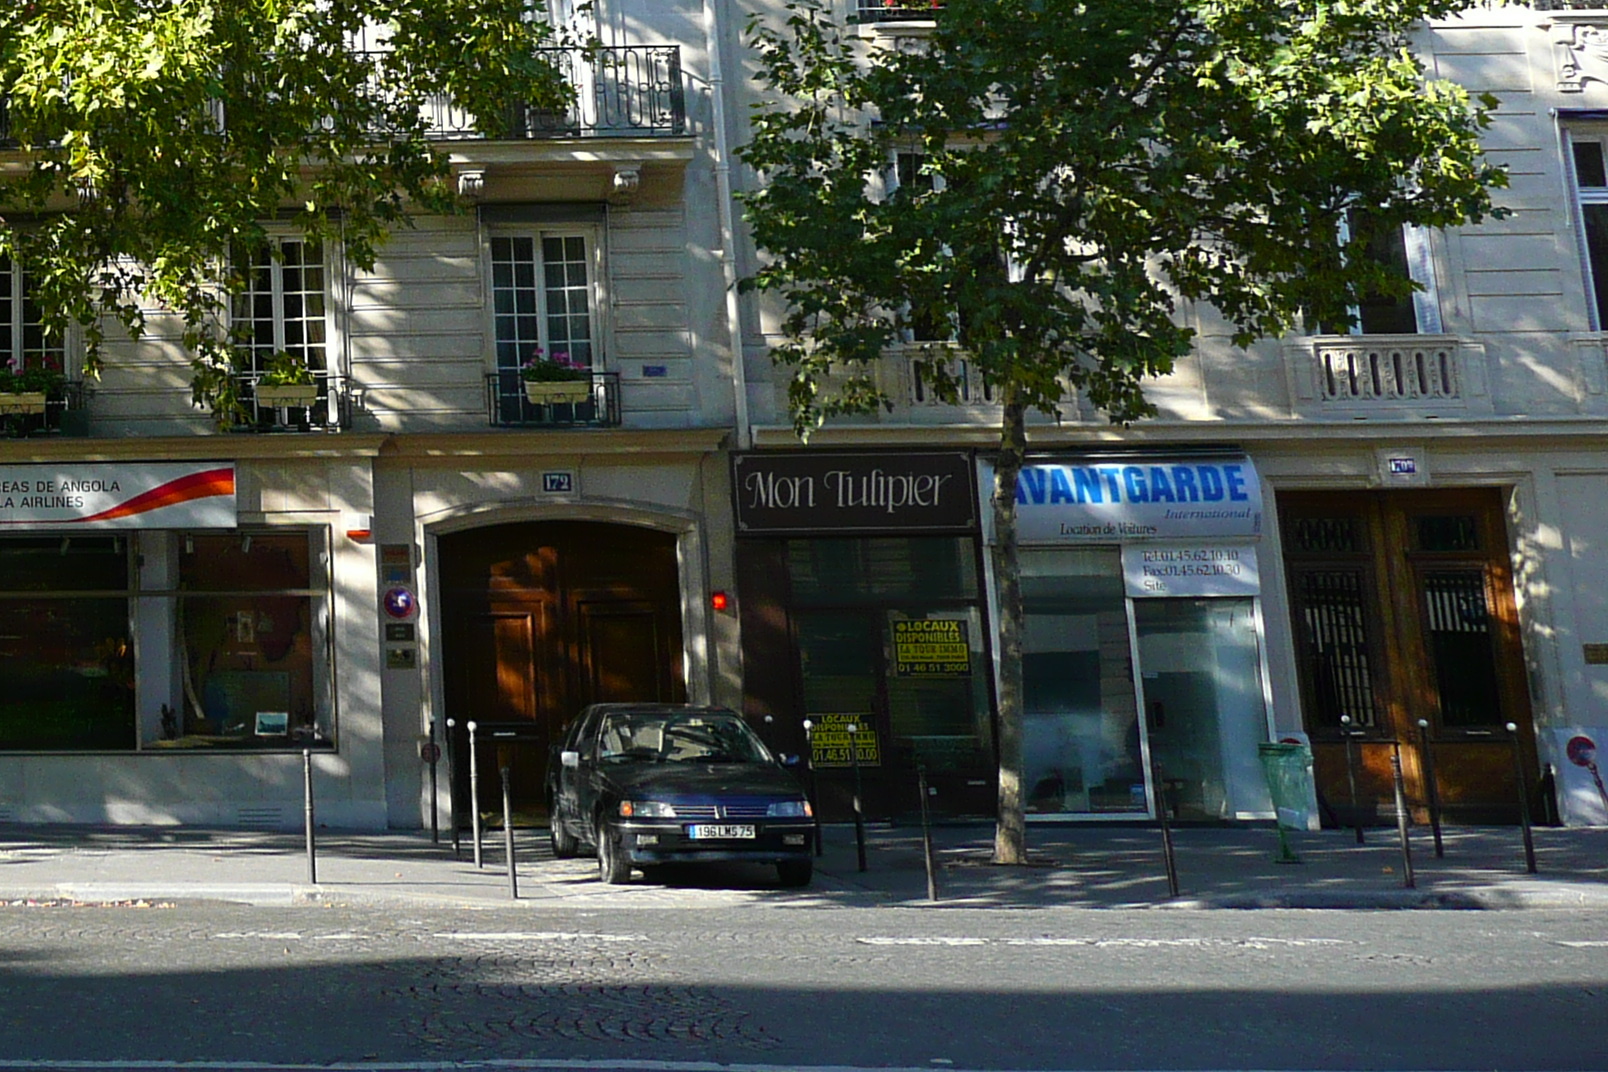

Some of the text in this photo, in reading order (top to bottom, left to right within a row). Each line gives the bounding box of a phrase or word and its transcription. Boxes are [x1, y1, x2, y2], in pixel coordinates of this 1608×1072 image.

[36, 480, 54, 493] DE
[60, 479, 121, 493] ANGOLA
[545, 474, 570, 490] 172
[745, 468, 953, 514] Mon Tulipier
[20, 495, 84, 508] AIRLINES
[1164, 507, 1252, 520] International
[1059, 522, 1158, 535] Location de Voitures
[1144, 580, 1166, 592] Site
[907, 621, 959, 632] LOCAUX
[896, 632, 960, 643] DISPONIBLES
[821, 714, 861, 723] LOCAUX
